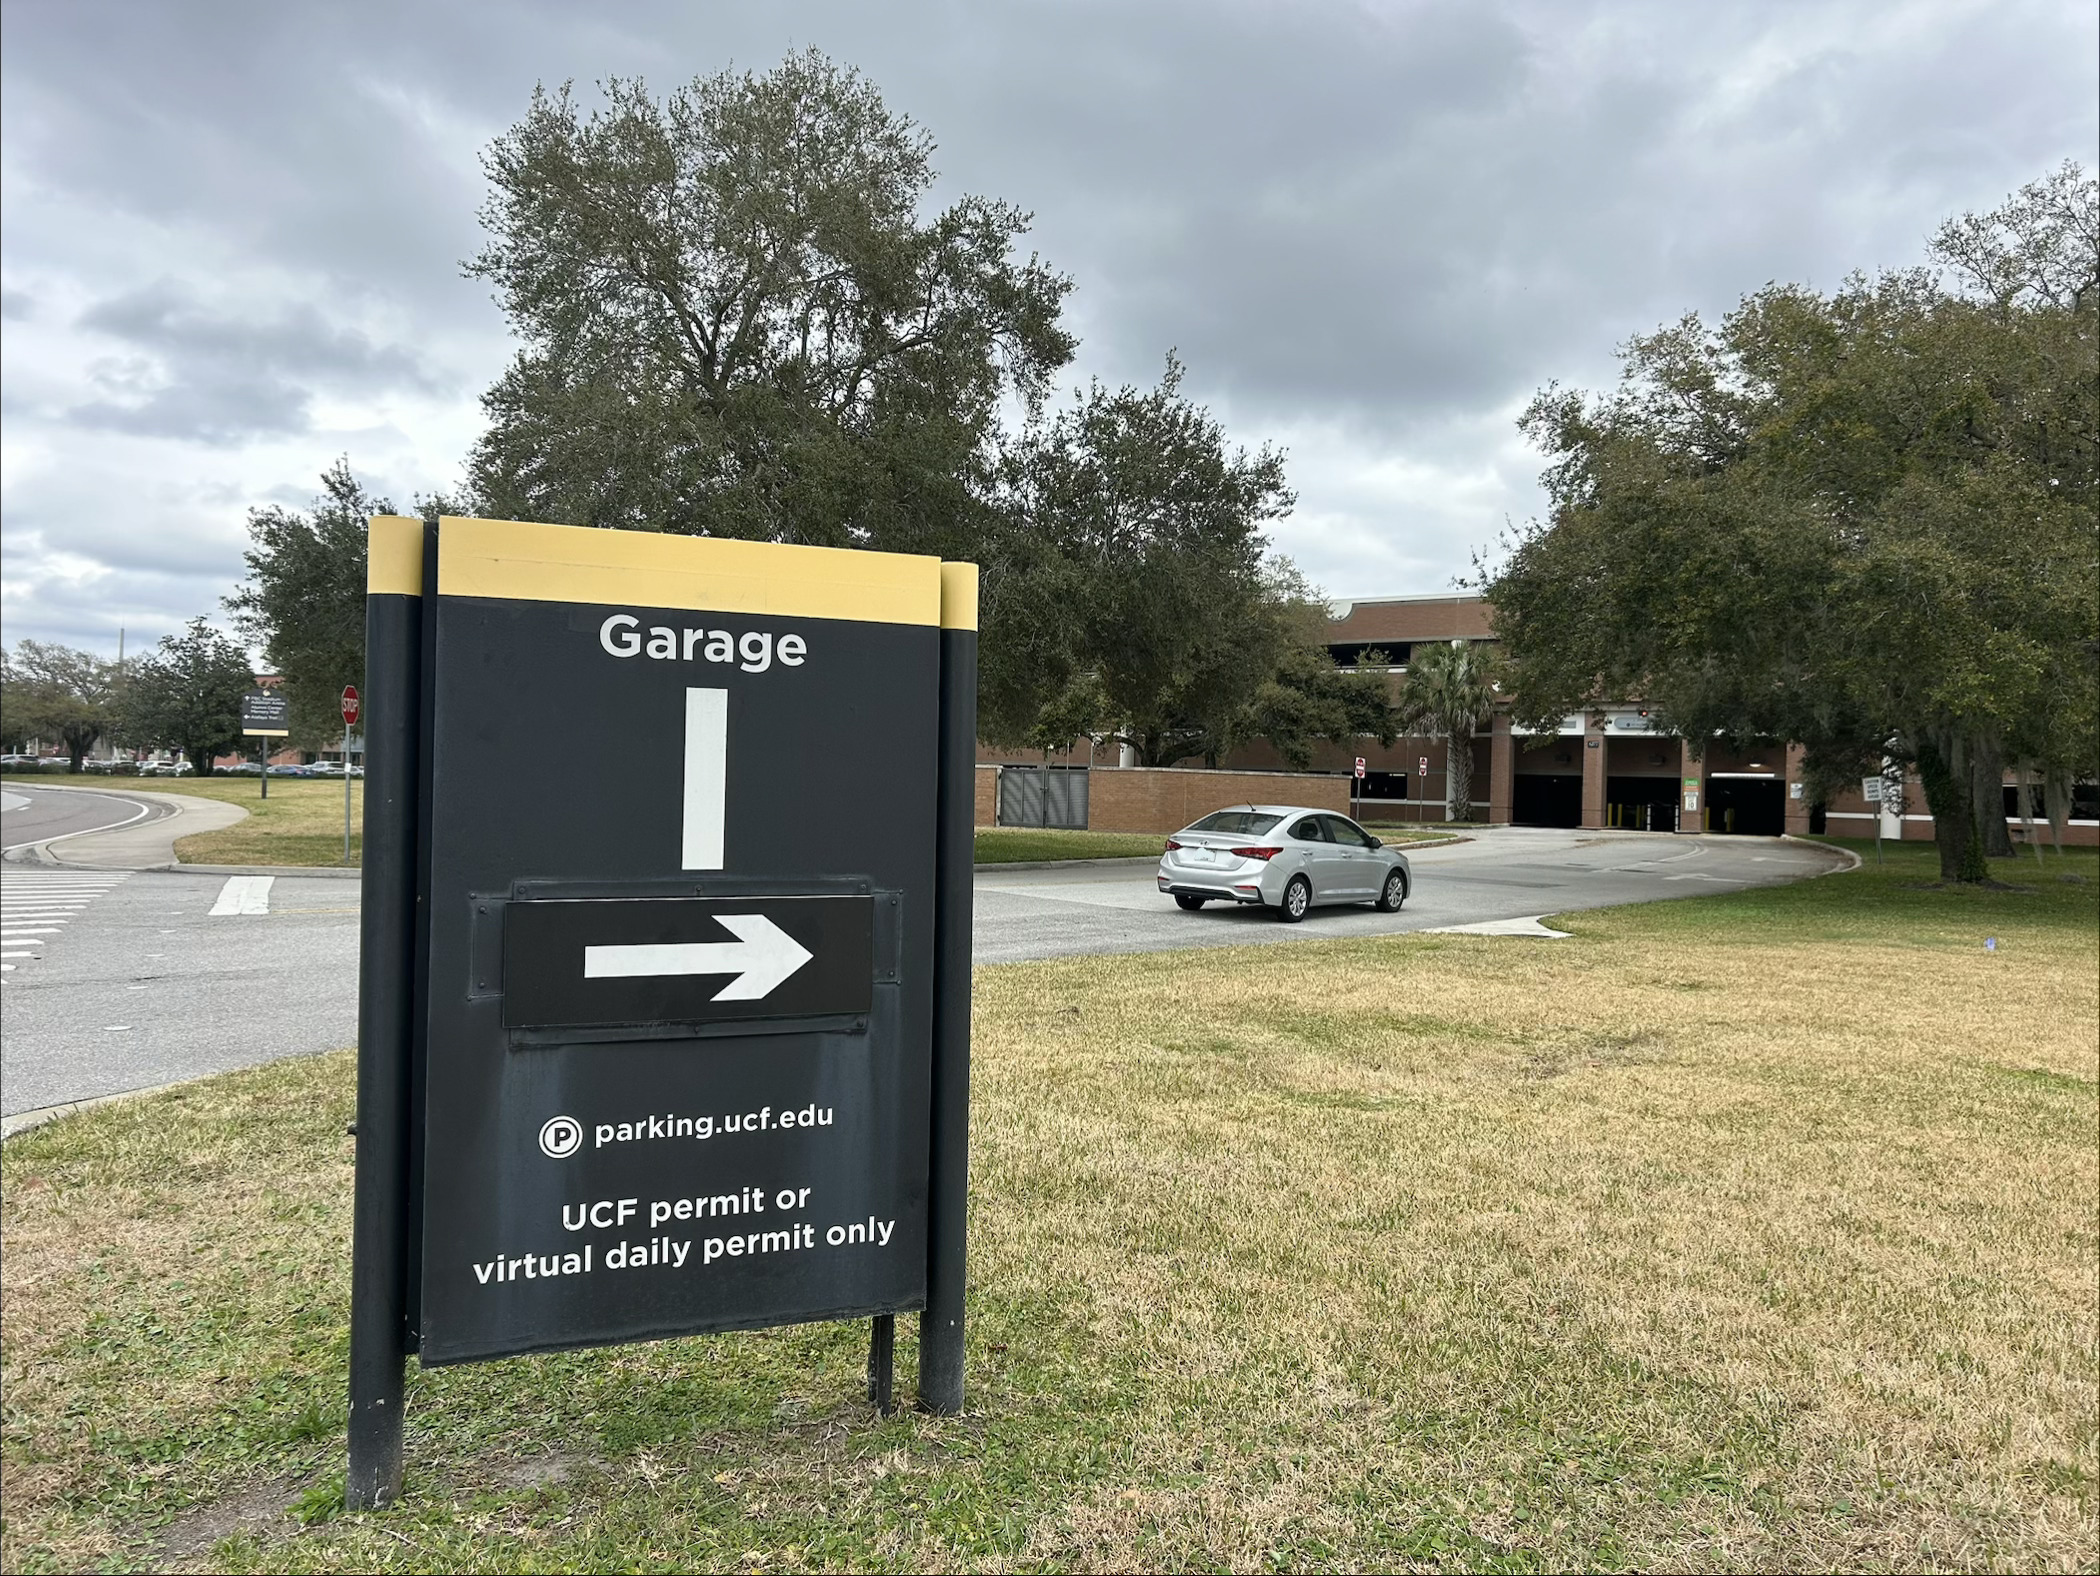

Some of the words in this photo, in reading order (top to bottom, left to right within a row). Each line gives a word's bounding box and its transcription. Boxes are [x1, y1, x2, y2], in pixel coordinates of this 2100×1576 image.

[599, 614, 807, 673] Garage
[343, 698, 358, 712] STOP
[595, 1103, 833, 1149] parking.ucf.edu
[562, 1198, 638, 1231] UCF
[650, 1186, 765, 1229] permit
[775, 1187, 811, 1210] or
[472, 1244, 592, 1284] virtual
[605, 1236, 692, 1270] daily
[703, 1222, 815, 1265] permit
[826, 1215, 896, 1246] only
